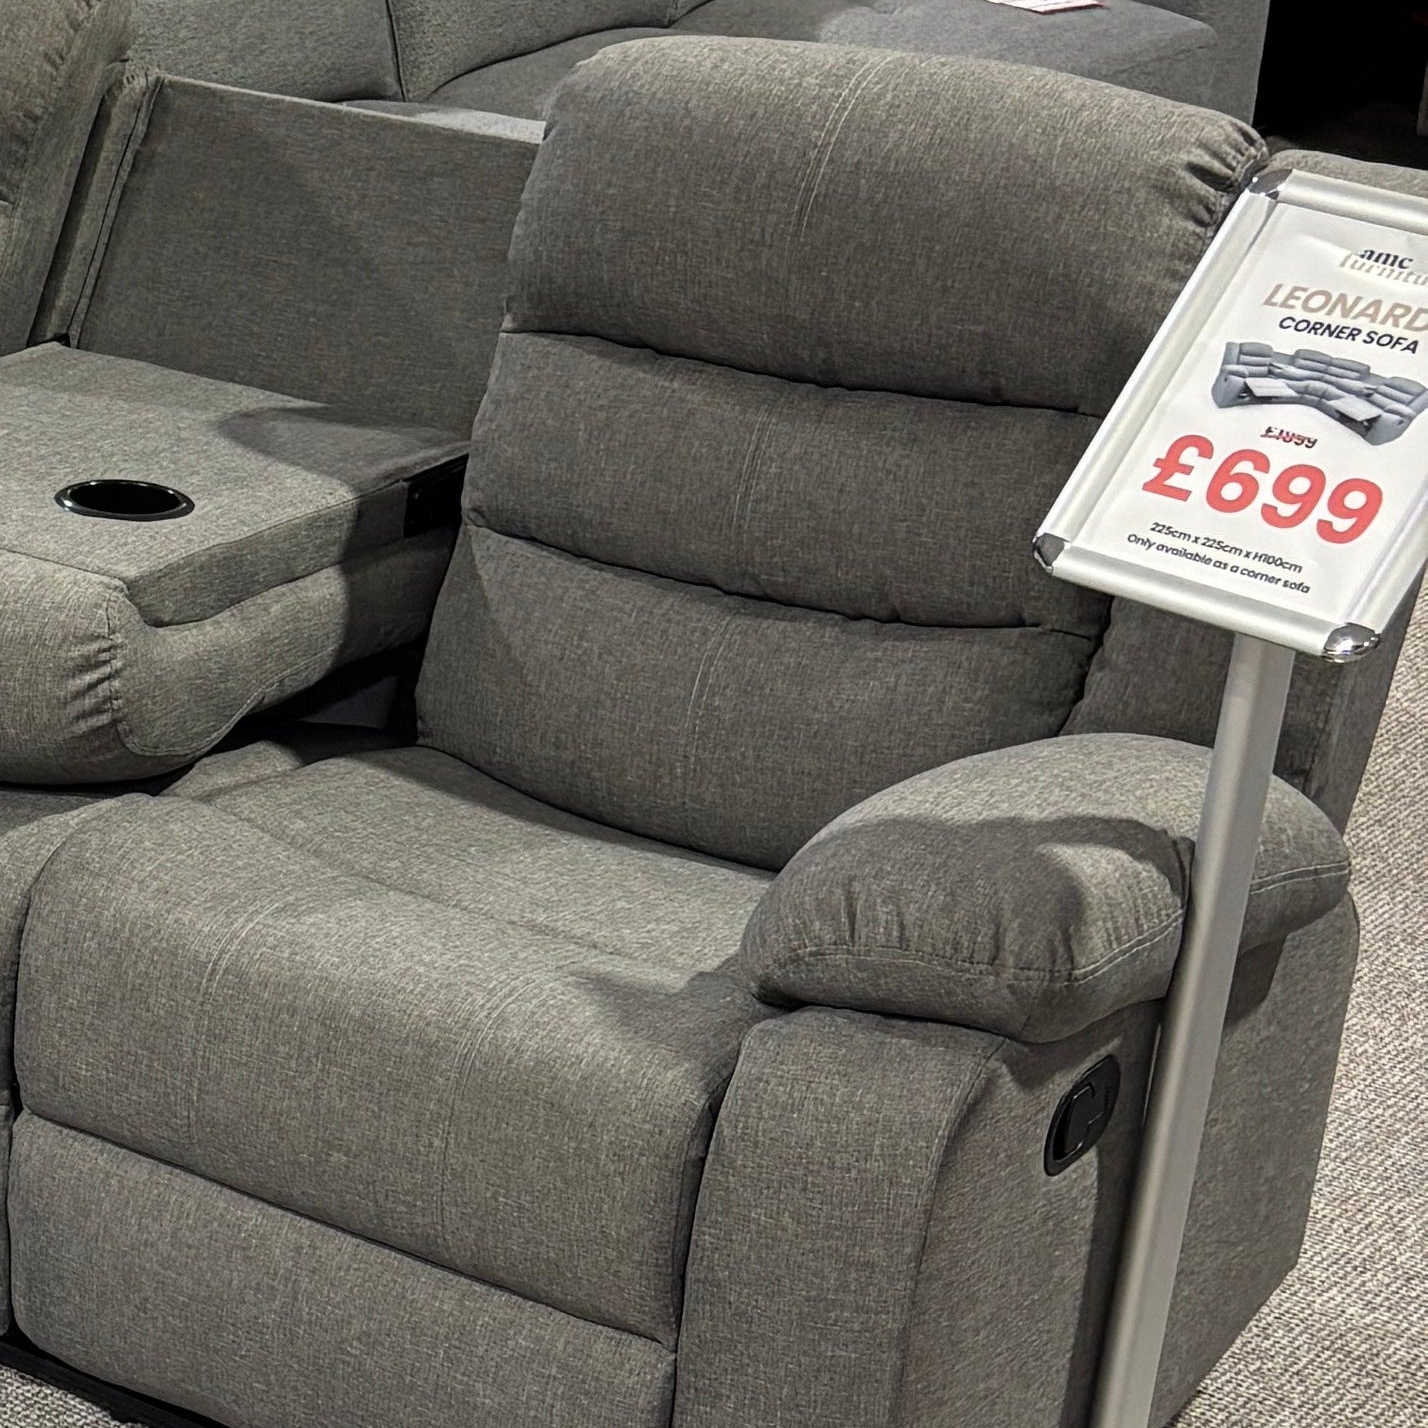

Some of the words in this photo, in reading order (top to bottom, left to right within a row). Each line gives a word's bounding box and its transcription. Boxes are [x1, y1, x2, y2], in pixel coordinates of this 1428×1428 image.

[1357, 249, 1414, 269] amc
[1262, 283, 1428, 332] LEONARD
[1278, 316, 1363, 342] CORNER
[1362, 331, 1420, 355] SOFA
[1142, 434, 1383, 545] £699
[1127, 533, 1156, 551] Only
[1156, 544, 1212, 566] available
[1213, 559, 1229, 571] as
[1230, 564, 1239, 574] a
[1240, 568, 1281, 586] corner
[1282, 577, 1311, 594] sofa
[1150, 522, 1192, 543] 225cm
[1201, 536, 1243, 557] 225cm
[1252, 552, 1303, 574] H100cm
